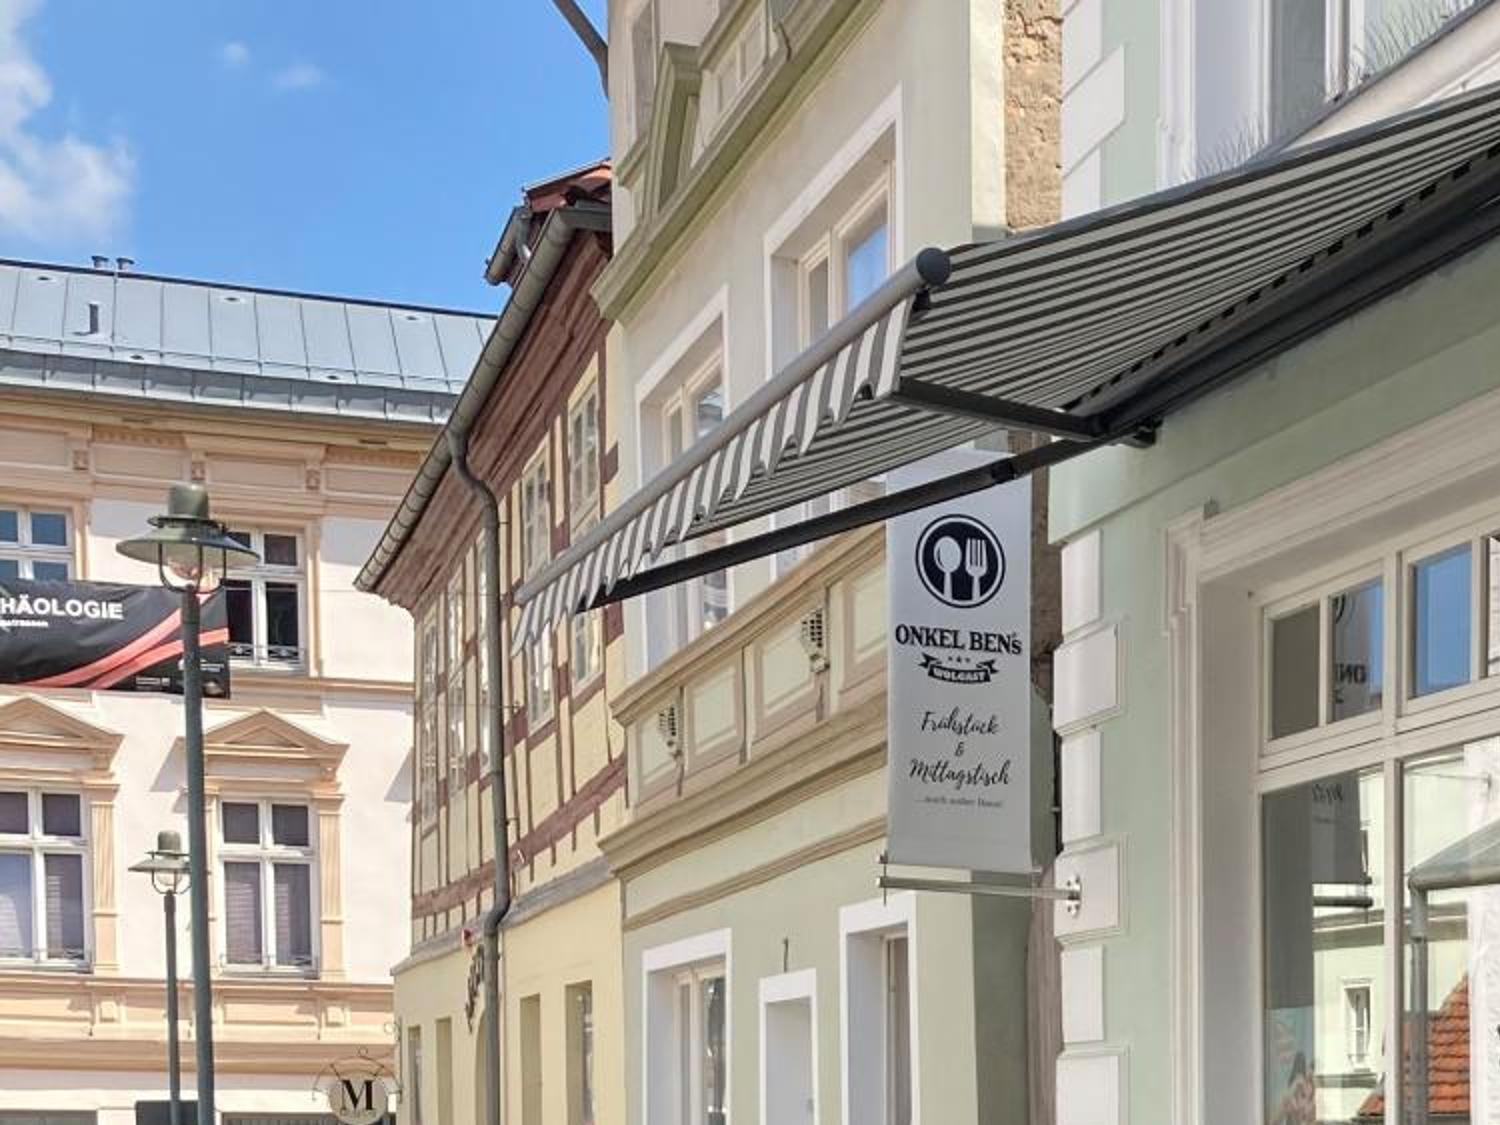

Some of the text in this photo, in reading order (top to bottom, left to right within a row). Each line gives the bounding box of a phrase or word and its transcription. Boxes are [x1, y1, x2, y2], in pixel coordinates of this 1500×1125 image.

[895, 623, 966, 650] ONKEL
[909, 759, 1011, 791] Mittagstisch
[341, 1079, 374, 1113] M
